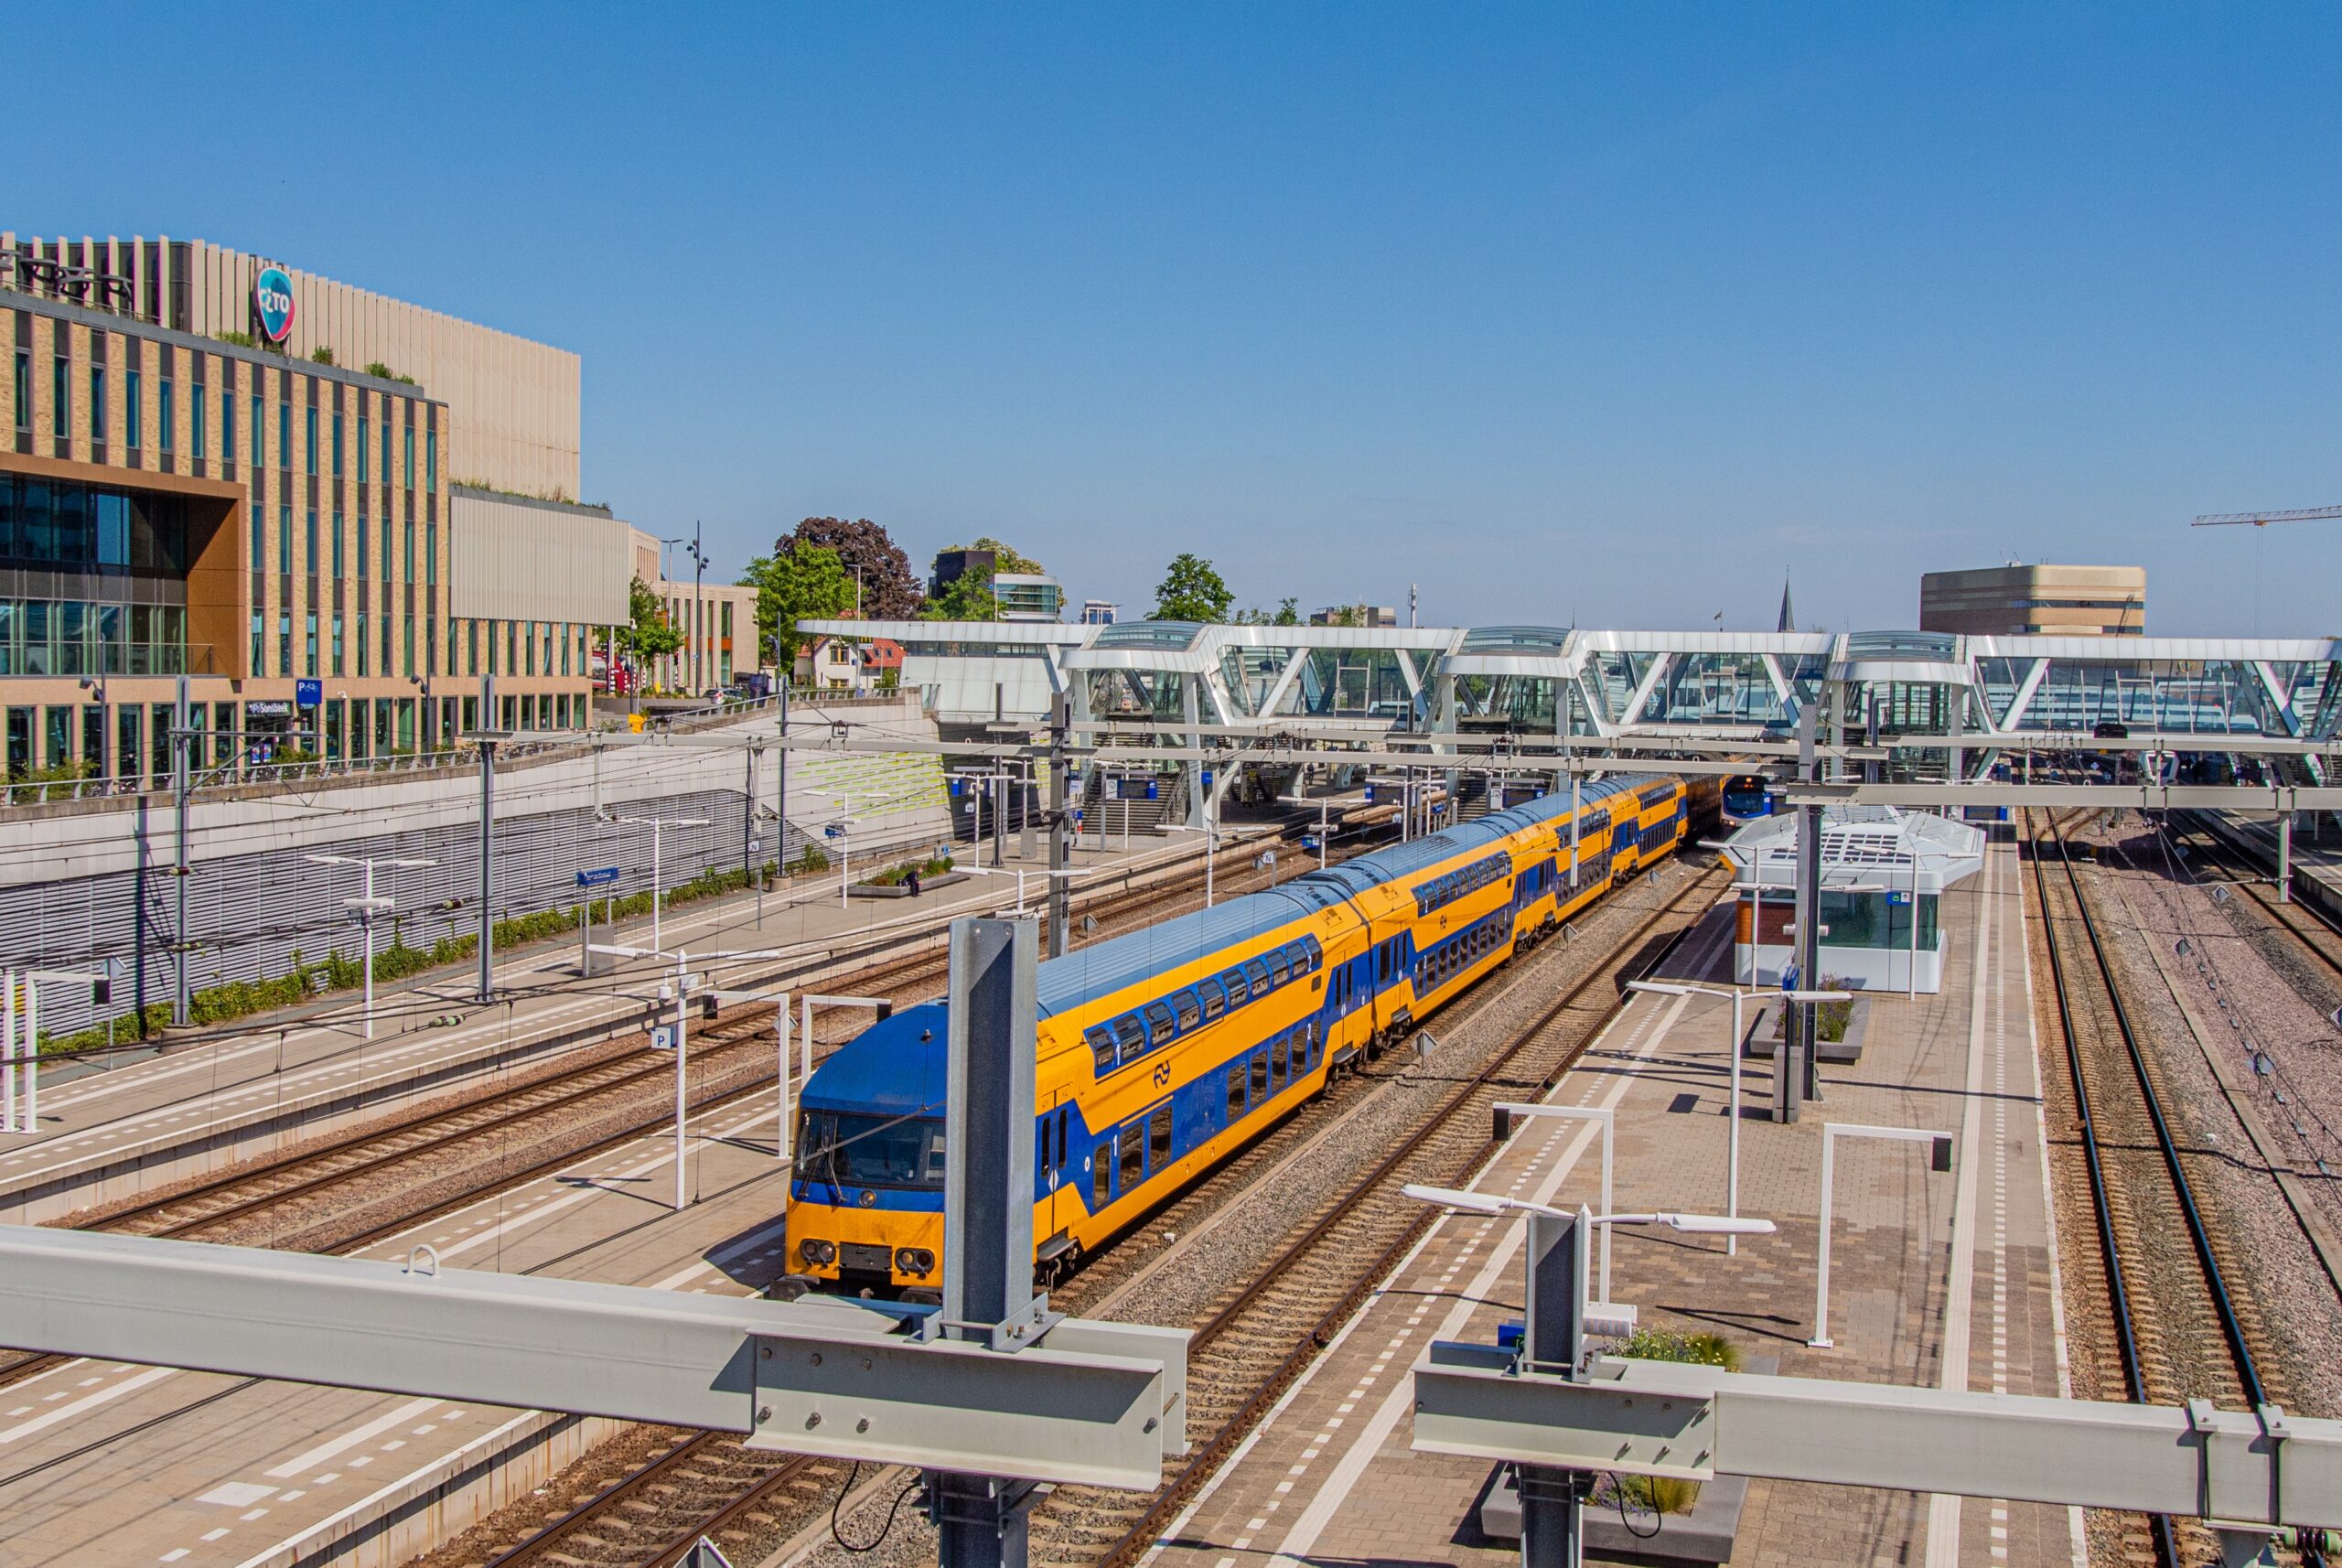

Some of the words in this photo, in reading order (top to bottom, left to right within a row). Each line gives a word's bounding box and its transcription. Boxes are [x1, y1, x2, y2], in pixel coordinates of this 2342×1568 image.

[298, 682, 306, 693] P
[260, 702, 289, 714] Sonsbeek
[1265, 854, 1272, 863] N
[1306, 955, 1312, 972] 2
[1306, 1023, 1312, 1040] 2
[658, 1035, 665, 1047] P
[1115, 1043, 1121, 1066] 1
[1112, 1133, 1118, 1157] 1
